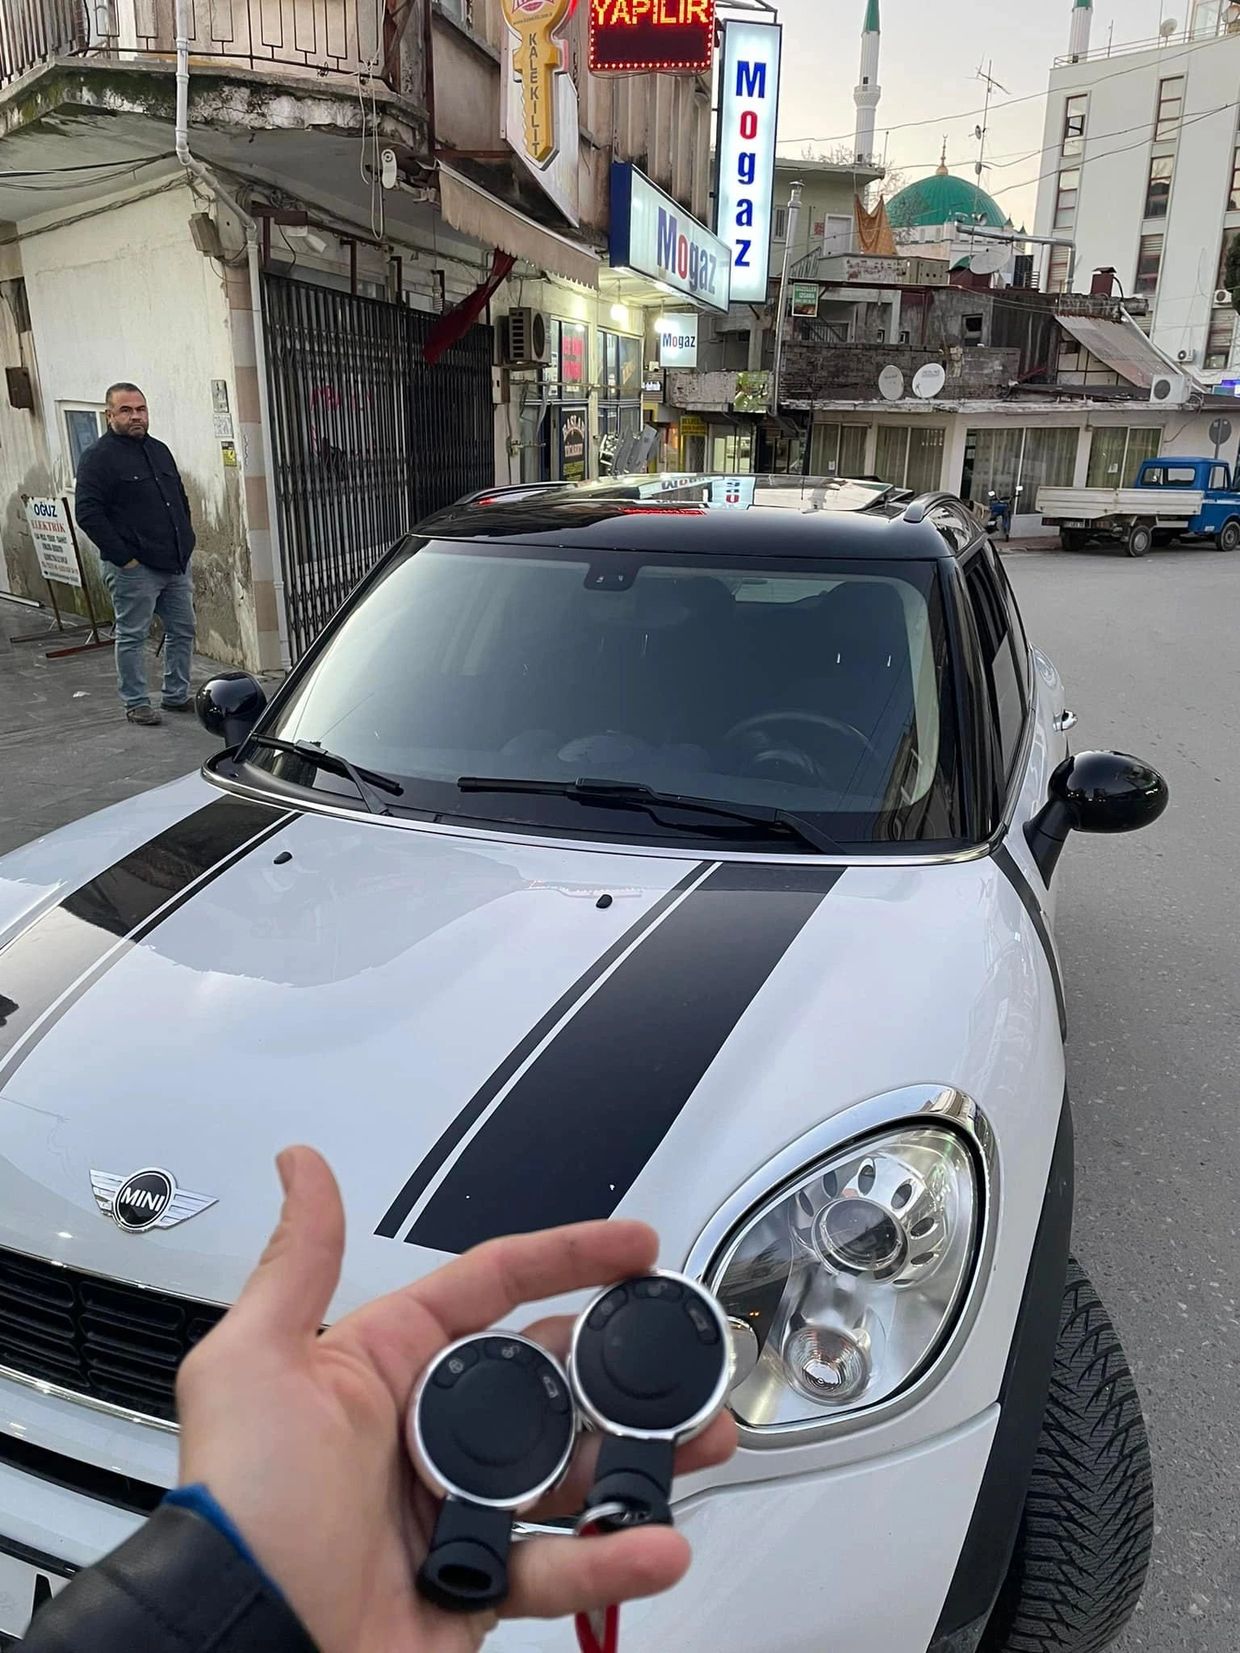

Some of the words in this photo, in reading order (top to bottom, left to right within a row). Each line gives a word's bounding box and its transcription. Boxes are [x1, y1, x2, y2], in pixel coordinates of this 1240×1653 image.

[592, 0, 709, 25] YAPILIR
[734, 60, 767, 267] Mogaz
[657, 206, 718, 296] Mogaz
[662, 332, 696, 349] Mogaz
[34, 502, 58, 517] OĞUZ
[120, 1187, 165, 1212] MINI
